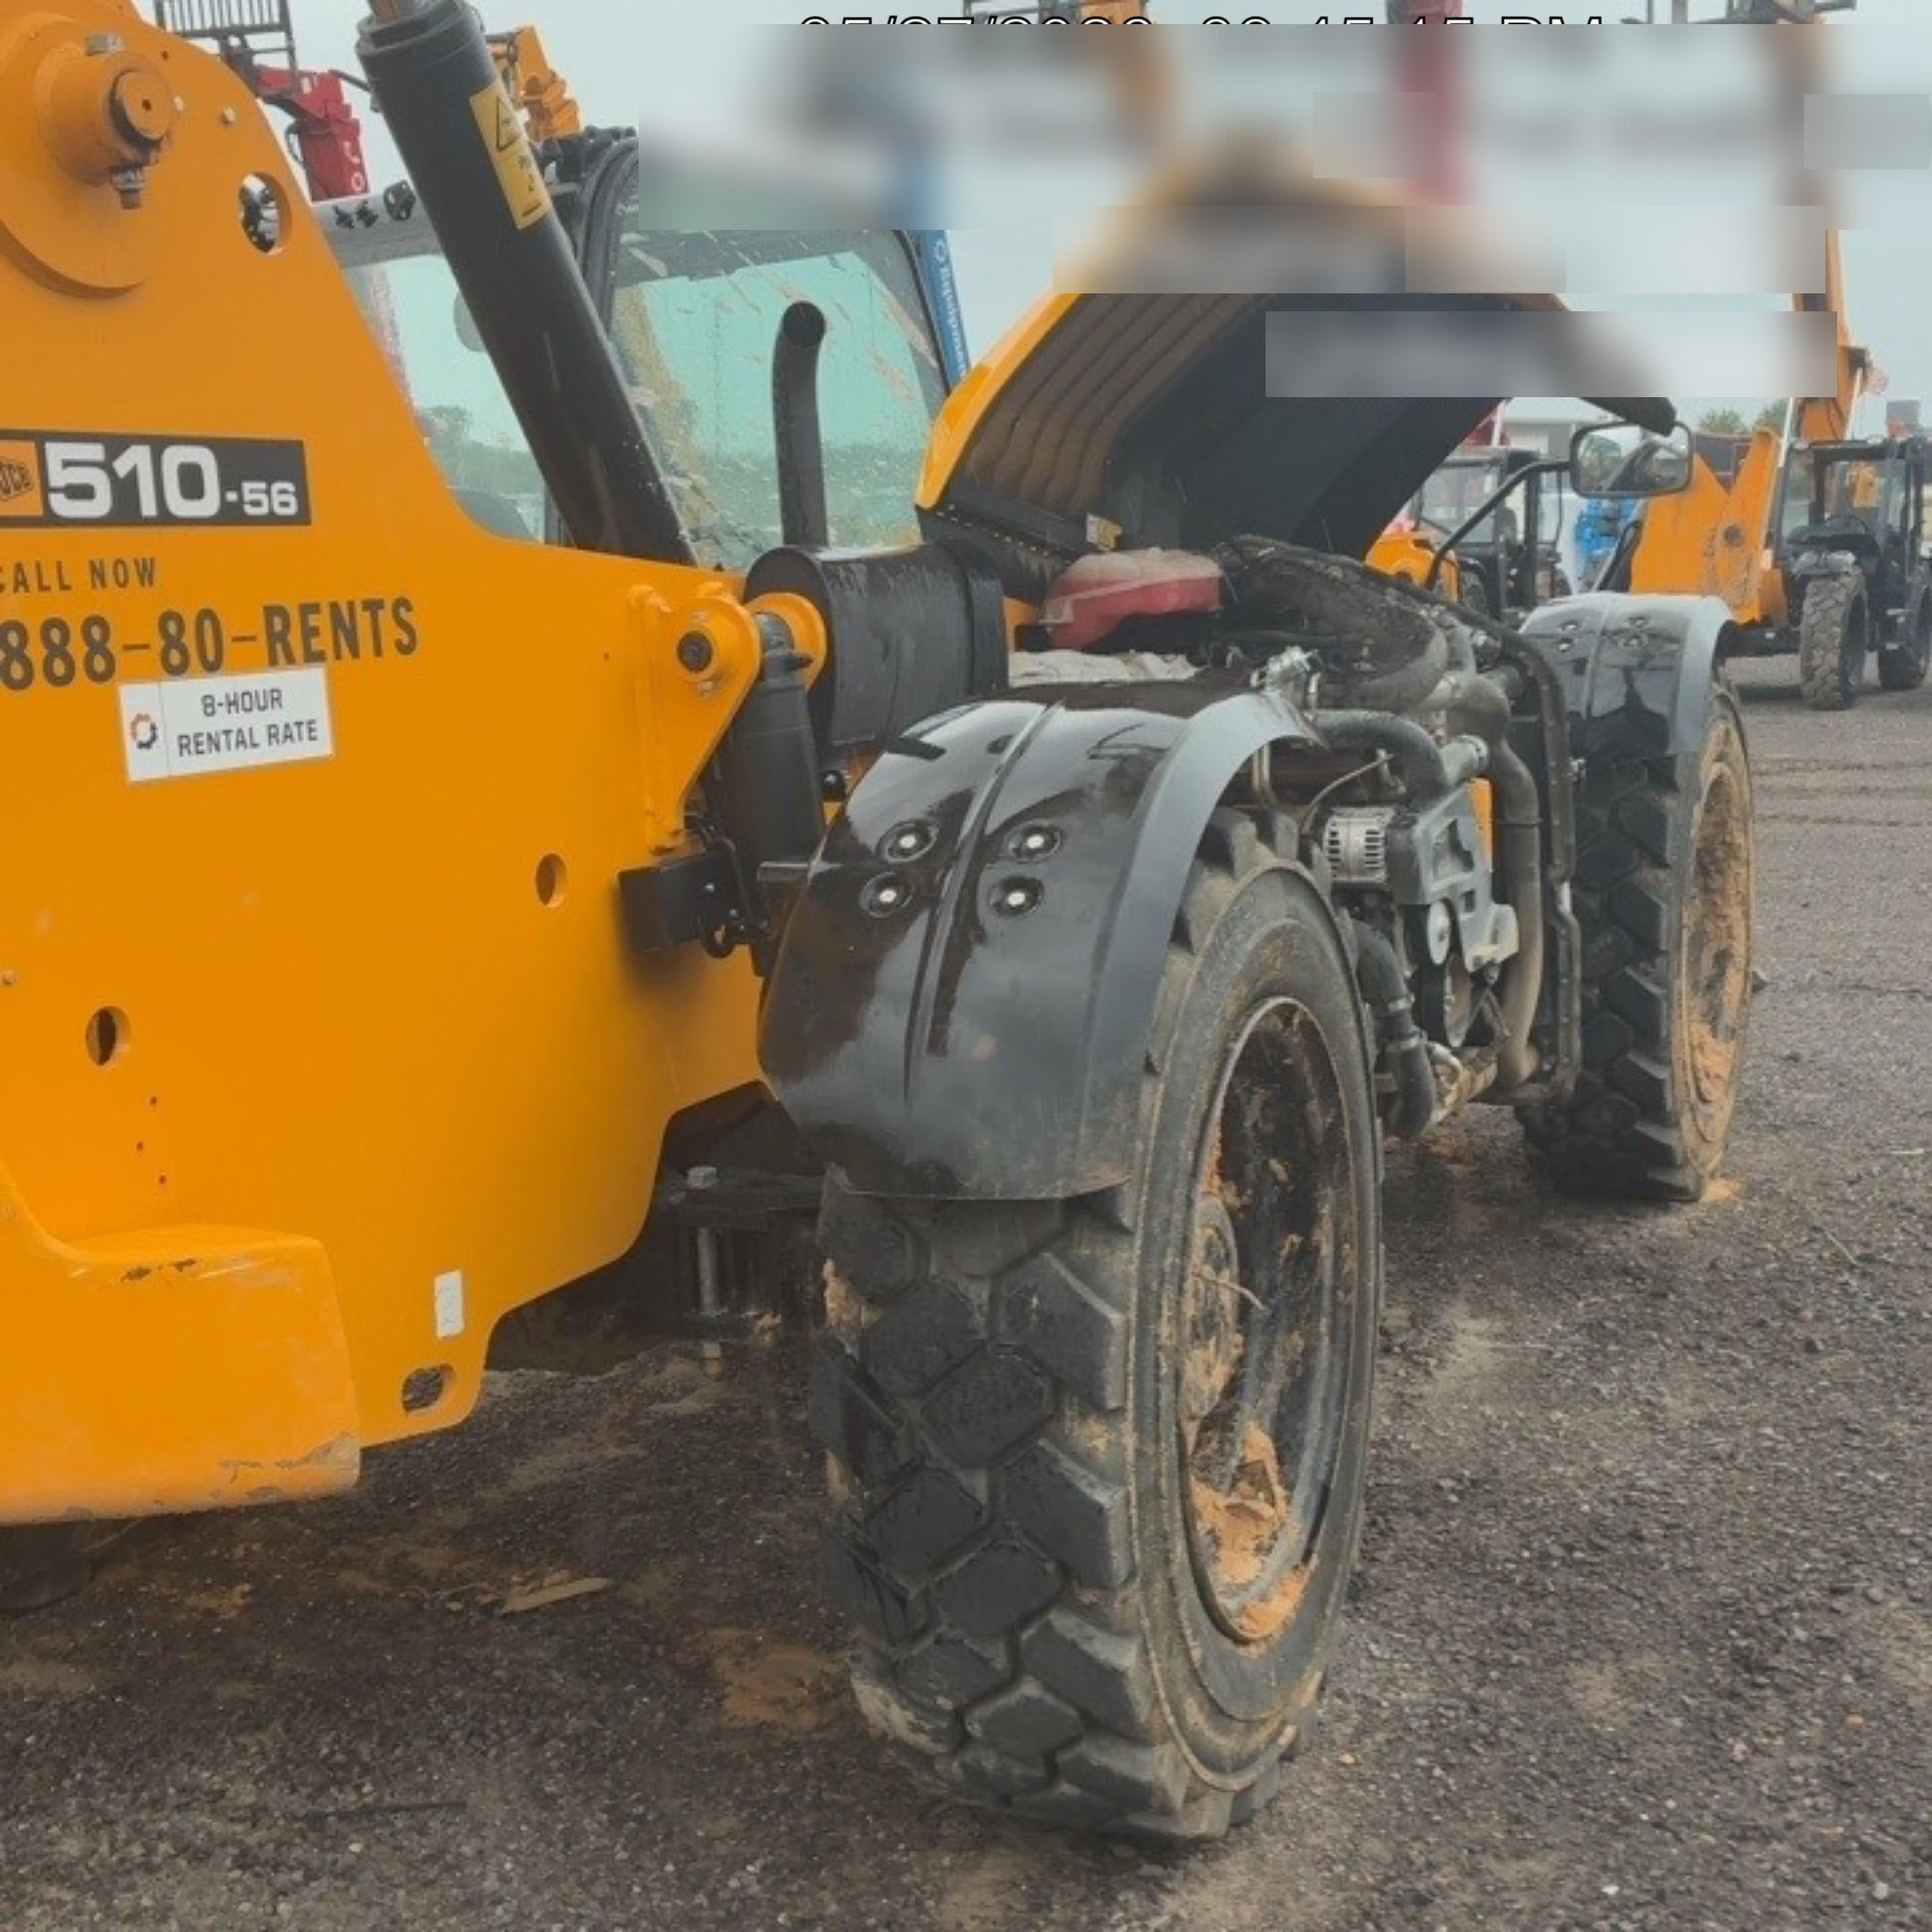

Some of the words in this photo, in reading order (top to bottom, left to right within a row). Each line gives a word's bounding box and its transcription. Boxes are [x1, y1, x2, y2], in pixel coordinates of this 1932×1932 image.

[89, 557, 156, 589] NOW
[200, 688, 284, 716] 8-HOUR
[177, 726, 260, 757] RENTAL
[267, 719, 318, 746] RATE
